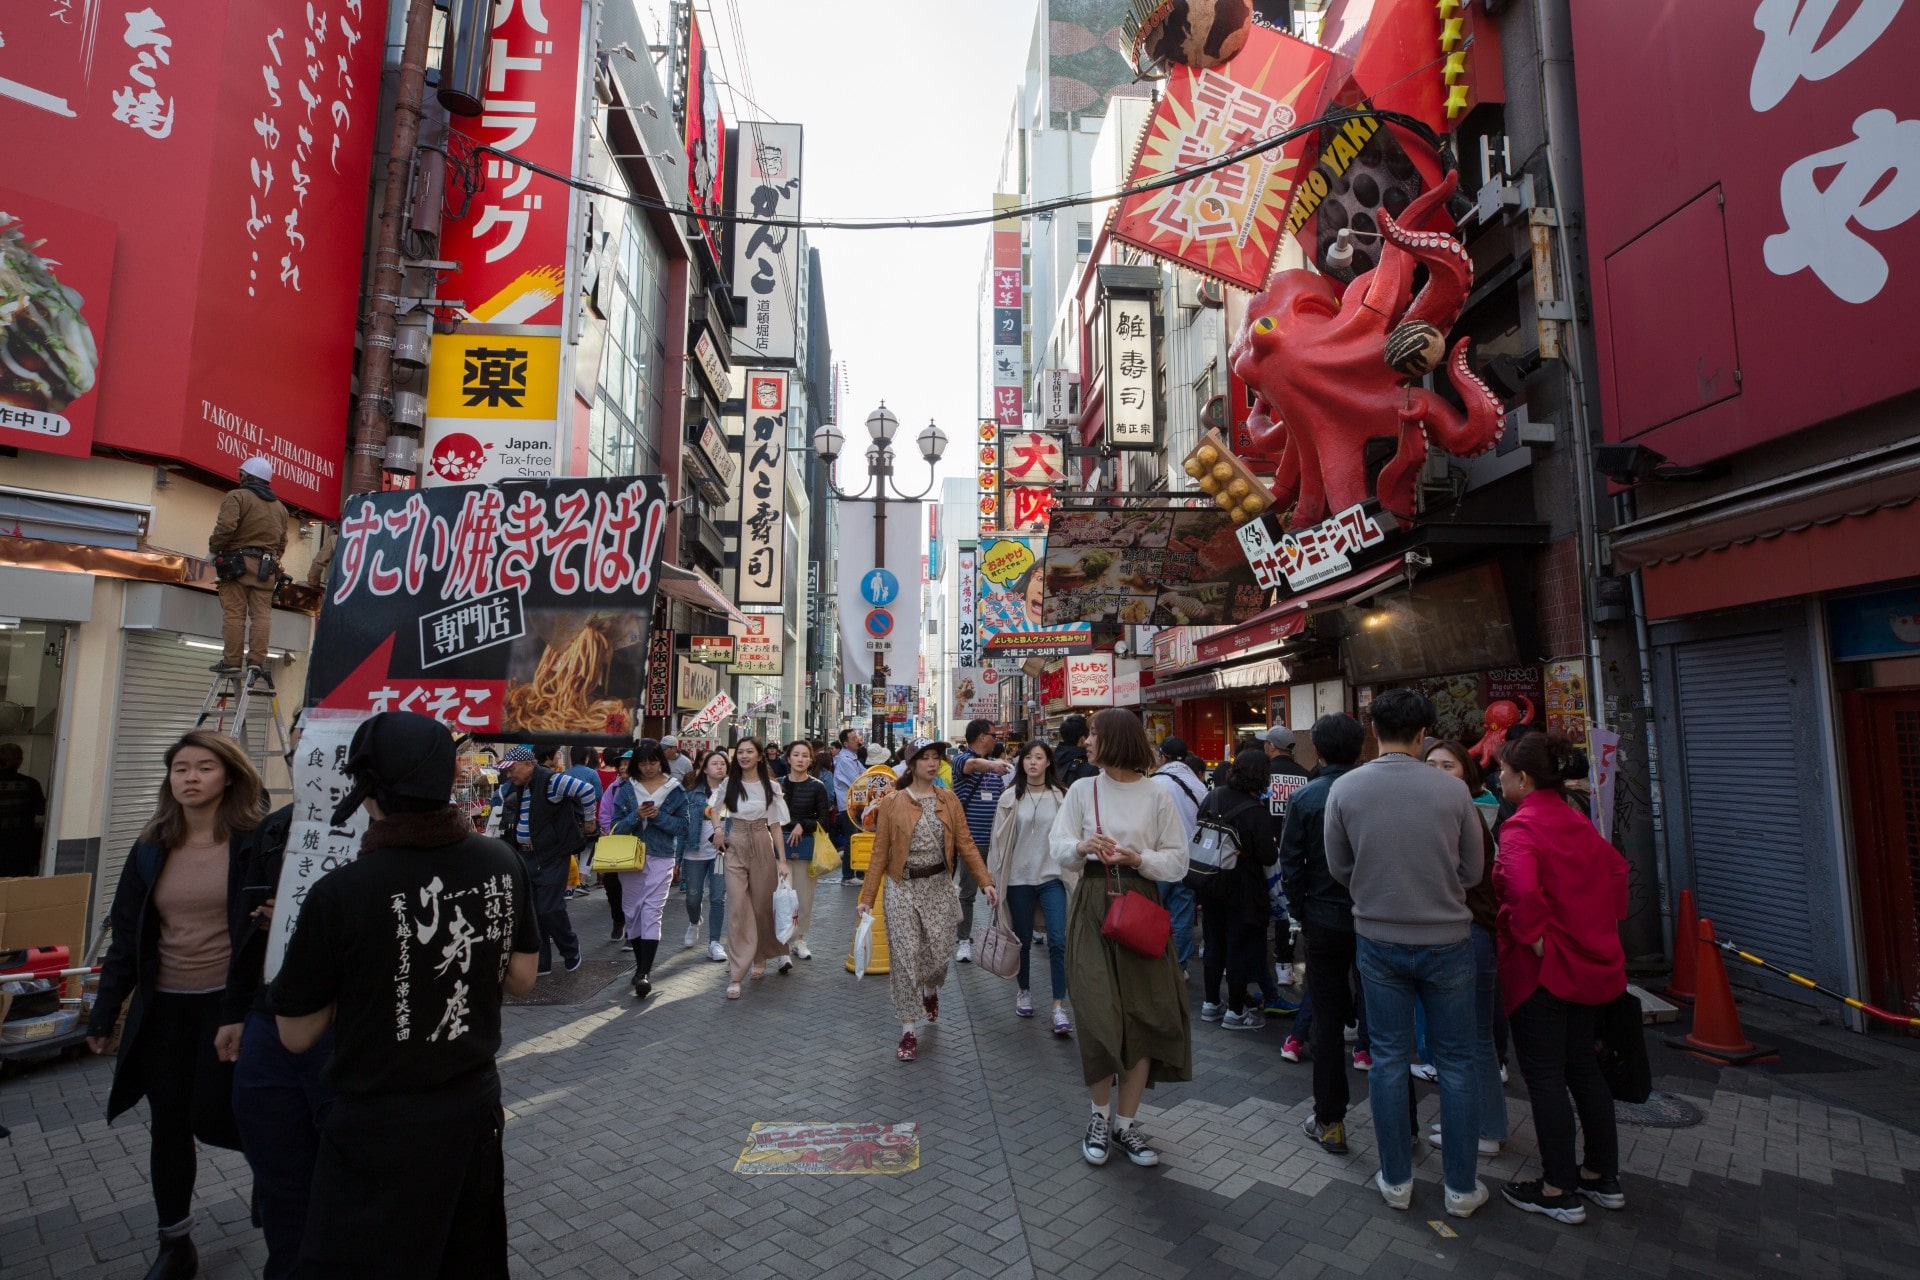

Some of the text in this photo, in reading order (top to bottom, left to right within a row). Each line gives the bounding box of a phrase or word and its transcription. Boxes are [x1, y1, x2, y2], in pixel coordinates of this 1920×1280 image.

[1320, 103, 1381, 176] YAKI
[745, 178, 799, 294] がんこ
[755, 299, 770, 350] 道頓堀店
[462, 347, 529, 408] 薬
[1115, 423, 1151, 435] 菊正宗
[505, 437, 552, 451] Japan.
[499, 453, 552, 466] Tax-free
[517, 467, 550, 476] Shop
[1003, 432, 1068, 531] 大阪
[333, 480, 666, 605] すごい焼きそば!
[986, 548, 1024, 571] おみやげ
[962, 574, 973, 614] 本場の味
[984, 592, 1025, 602] よしもと
[985, 604, 1025, 615] エンタメ
[432, 597, 511, 655] 専門店
[985, 616, 1025, 628] ショップ
[866, 641, 892, 650] 自動車
[1070, 662, 1108, 672] よしもと
[984, 672, 997, 681] 2F
[1072, 673, 1109, 684] エンタメ
[1072, 685, 1109, 695] ショップ
[1282, 775, 1306, 785] GOOD
[483, 874, 505, 943] 道頓堀
